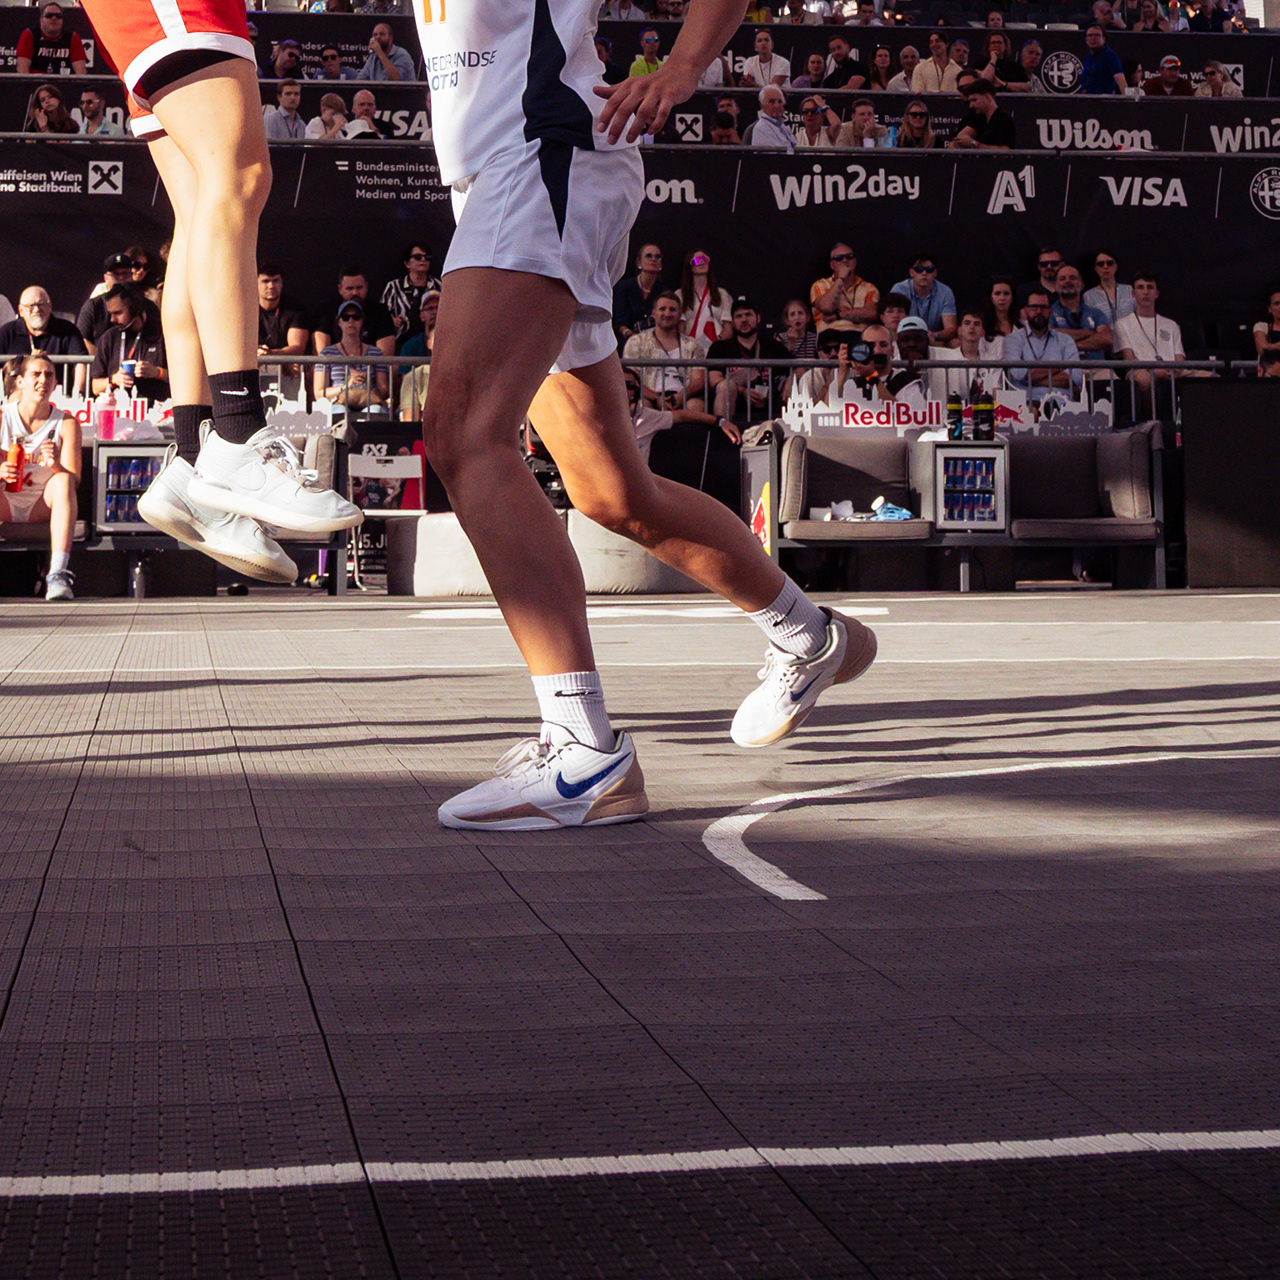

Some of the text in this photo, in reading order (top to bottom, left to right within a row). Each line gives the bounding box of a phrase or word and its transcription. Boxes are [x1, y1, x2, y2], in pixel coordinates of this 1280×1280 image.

[1036, 118, 1155, 150] Wilson
[18, 182, 82, 194] Stadtbank
[50, 171, 82, 182] Wien
[356, 176, 404, 188] Wohnen,
[770, 163, 920, 211] win2day
[1251, 172, 1269, 195] ALFA
[356, 189, 452, 202] Medien und Spor
[987, 165, 1035, 215] A1
[1099, 176, 1188, 207] VISA
[845, 401, 941, 426] Red Bull
